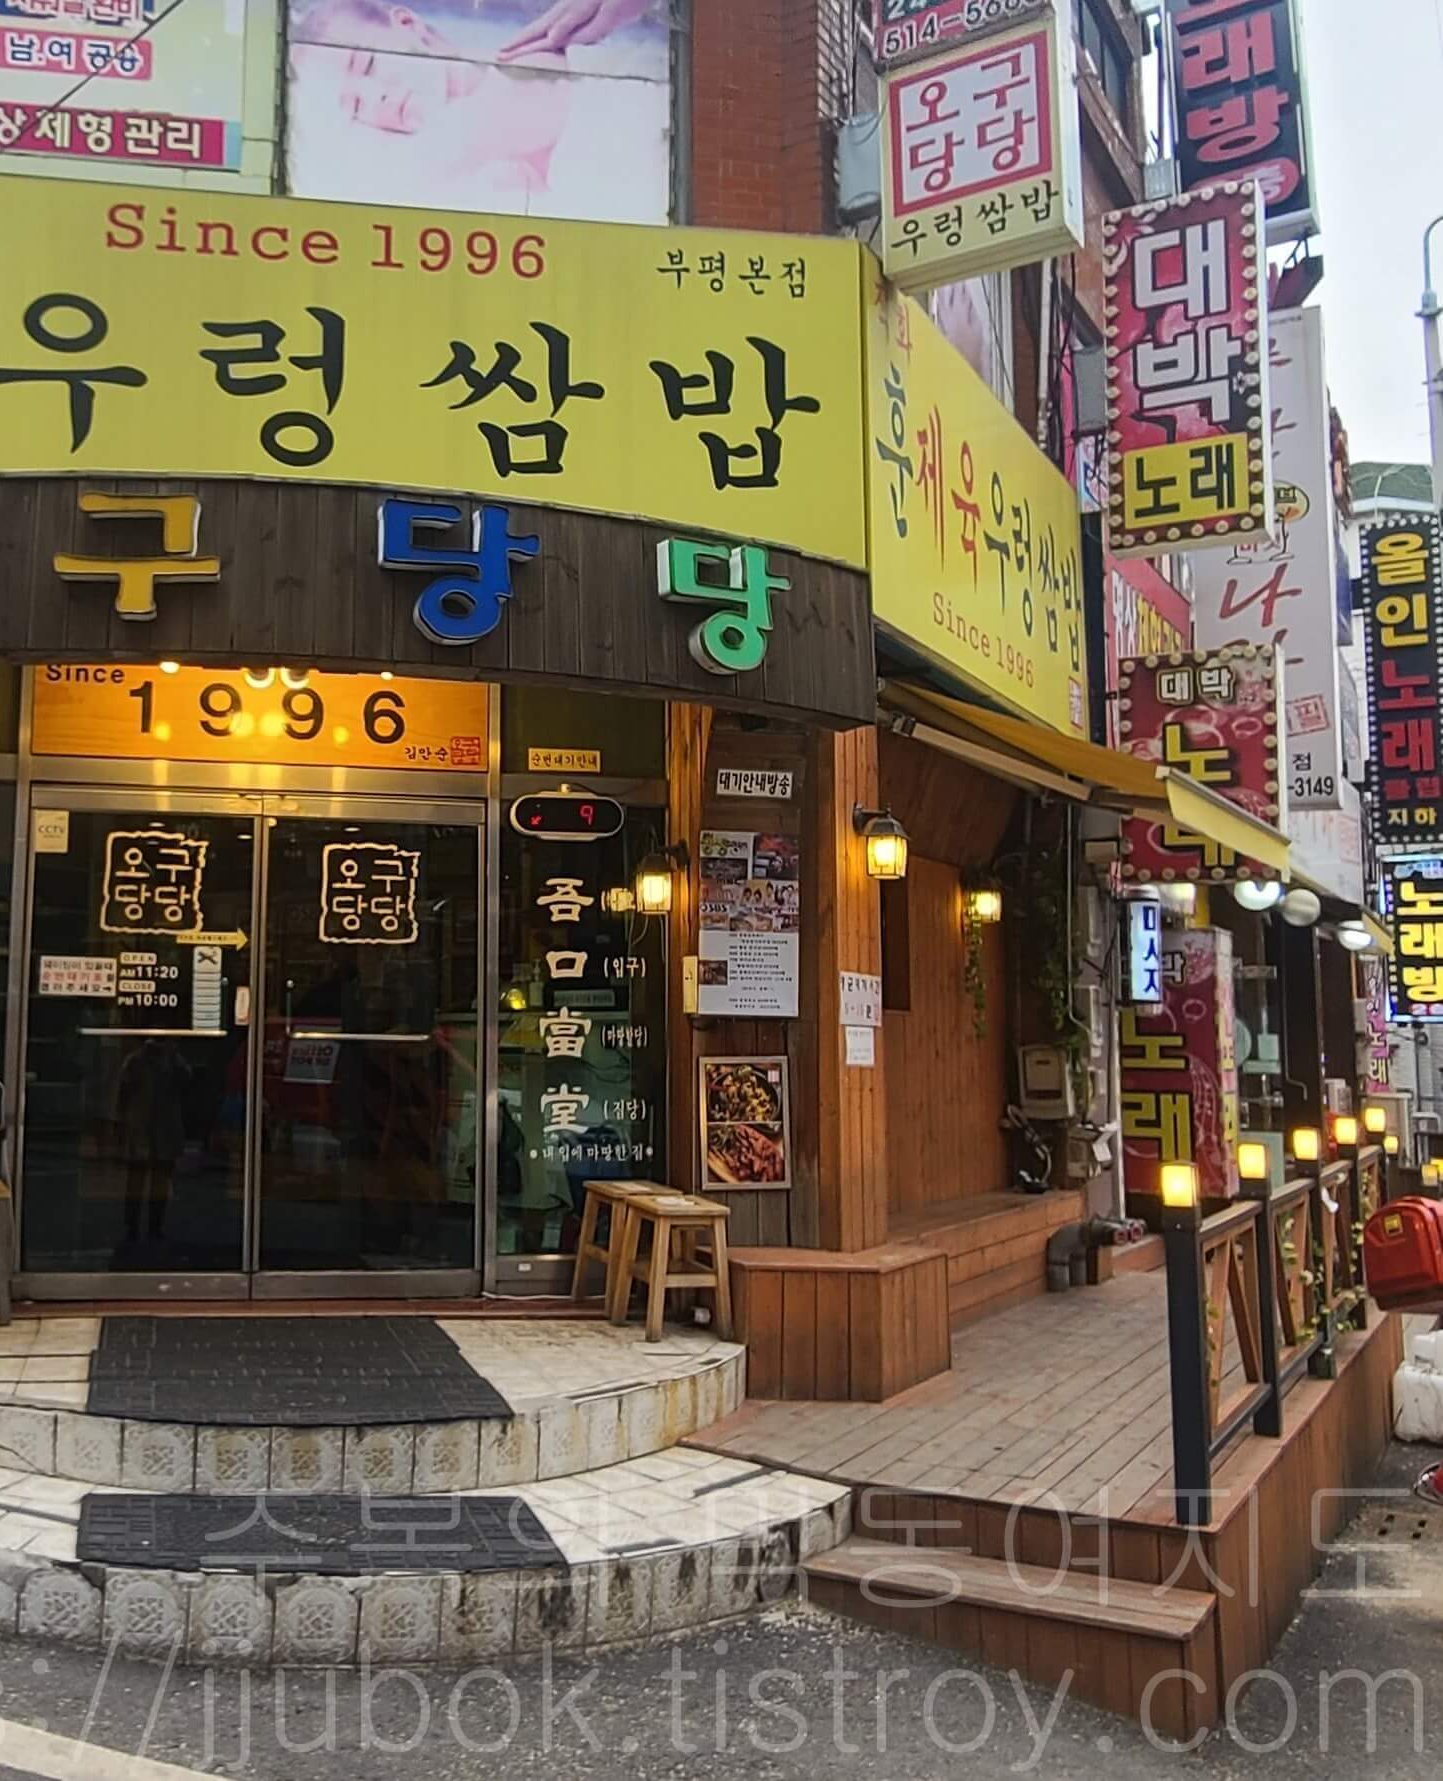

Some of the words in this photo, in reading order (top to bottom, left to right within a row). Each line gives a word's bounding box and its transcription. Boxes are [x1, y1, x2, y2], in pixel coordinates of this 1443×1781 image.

[1176, 0, 1289, 163] 래방
[104, 202, 341, 267] Since
[370, 224, 547, 279] 1996
[890, 179, 1060, 257] 우렁쌈밥
[1134, 218, 1245, 424] 대박
[1134, 441, 1236, 519] 노래
[1371, 532, 1430, 648] 올인
[932, 591, 992, 660] Since
[995, 635, 1035, 690] 1996
[45, 663, 126, 685] Since
[129, 680, 406, 745] 1996
[1160, 666, 1235, 701] 대박
[719, 770, 791, 797] 대기안내방송
[1387, 807, 1439, 828] 지하
[603, 955, 647, 979] (입구)
[1121, 1007, 1192, 1161] 노래
